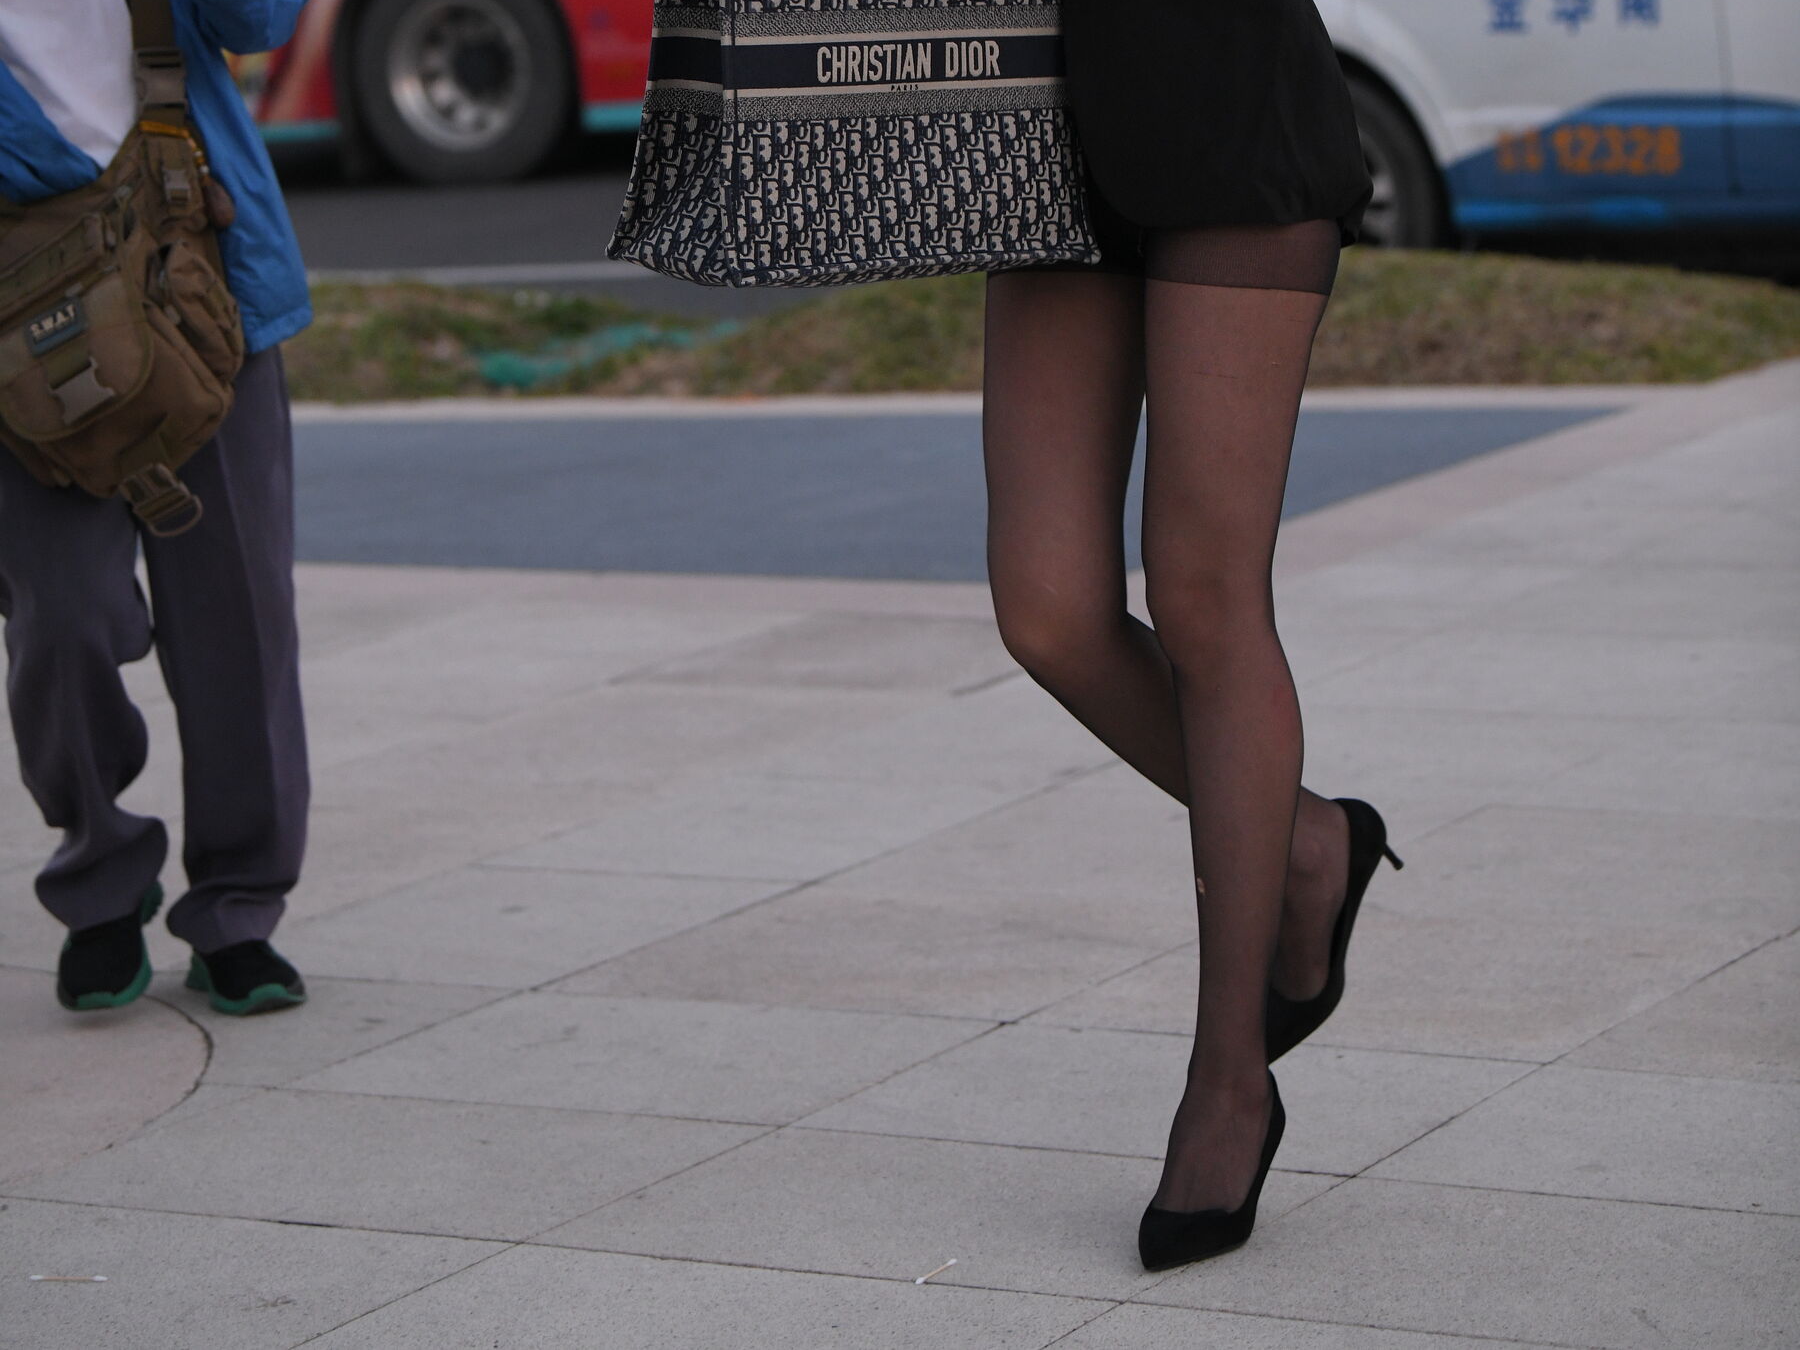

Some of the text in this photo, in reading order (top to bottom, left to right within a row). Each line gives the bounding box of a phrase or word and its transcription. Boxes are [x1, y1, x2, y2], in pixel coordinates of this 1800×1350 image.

[817, 40, 1001, 83] CHRISTIAN DIOR
[890, 83, 919, 92] PARIS
